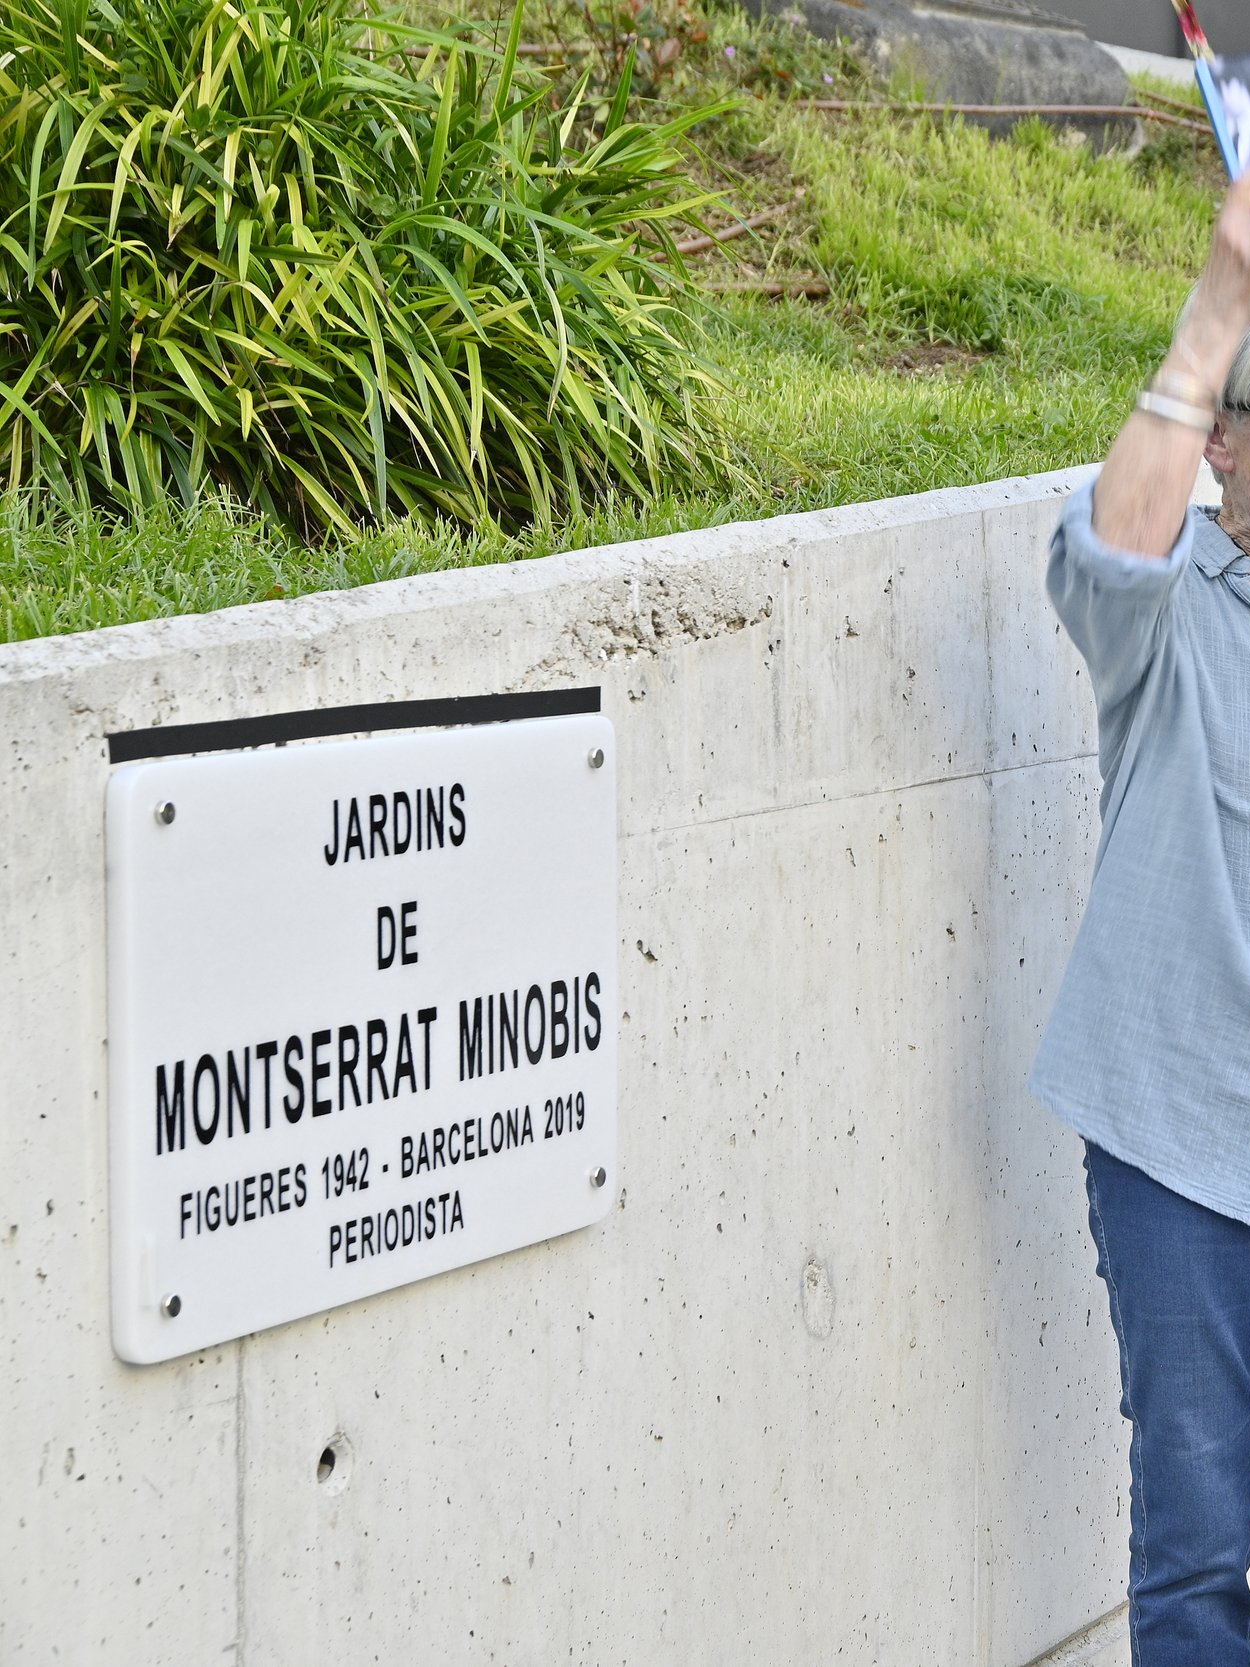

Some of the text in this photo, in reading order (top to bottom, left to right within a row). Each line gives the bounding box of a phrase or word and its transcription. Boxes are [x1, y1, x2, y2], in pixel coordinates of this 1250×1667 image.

[324, 783, 466, 867] JARDINS
[377, 901, 419, 970] DE
[156, 971, 602, 1156] MONTSERRAT MINOBIS
[180, 1163, 307, 1240] FIGUERES
[321, 1147, 369, 1200] 1942
[401, 1111, 533, 1179] BARCELONA
[544, 1092, 585, 1140] 2019
[329, 1190, 464, 1269] PERIODISTA
